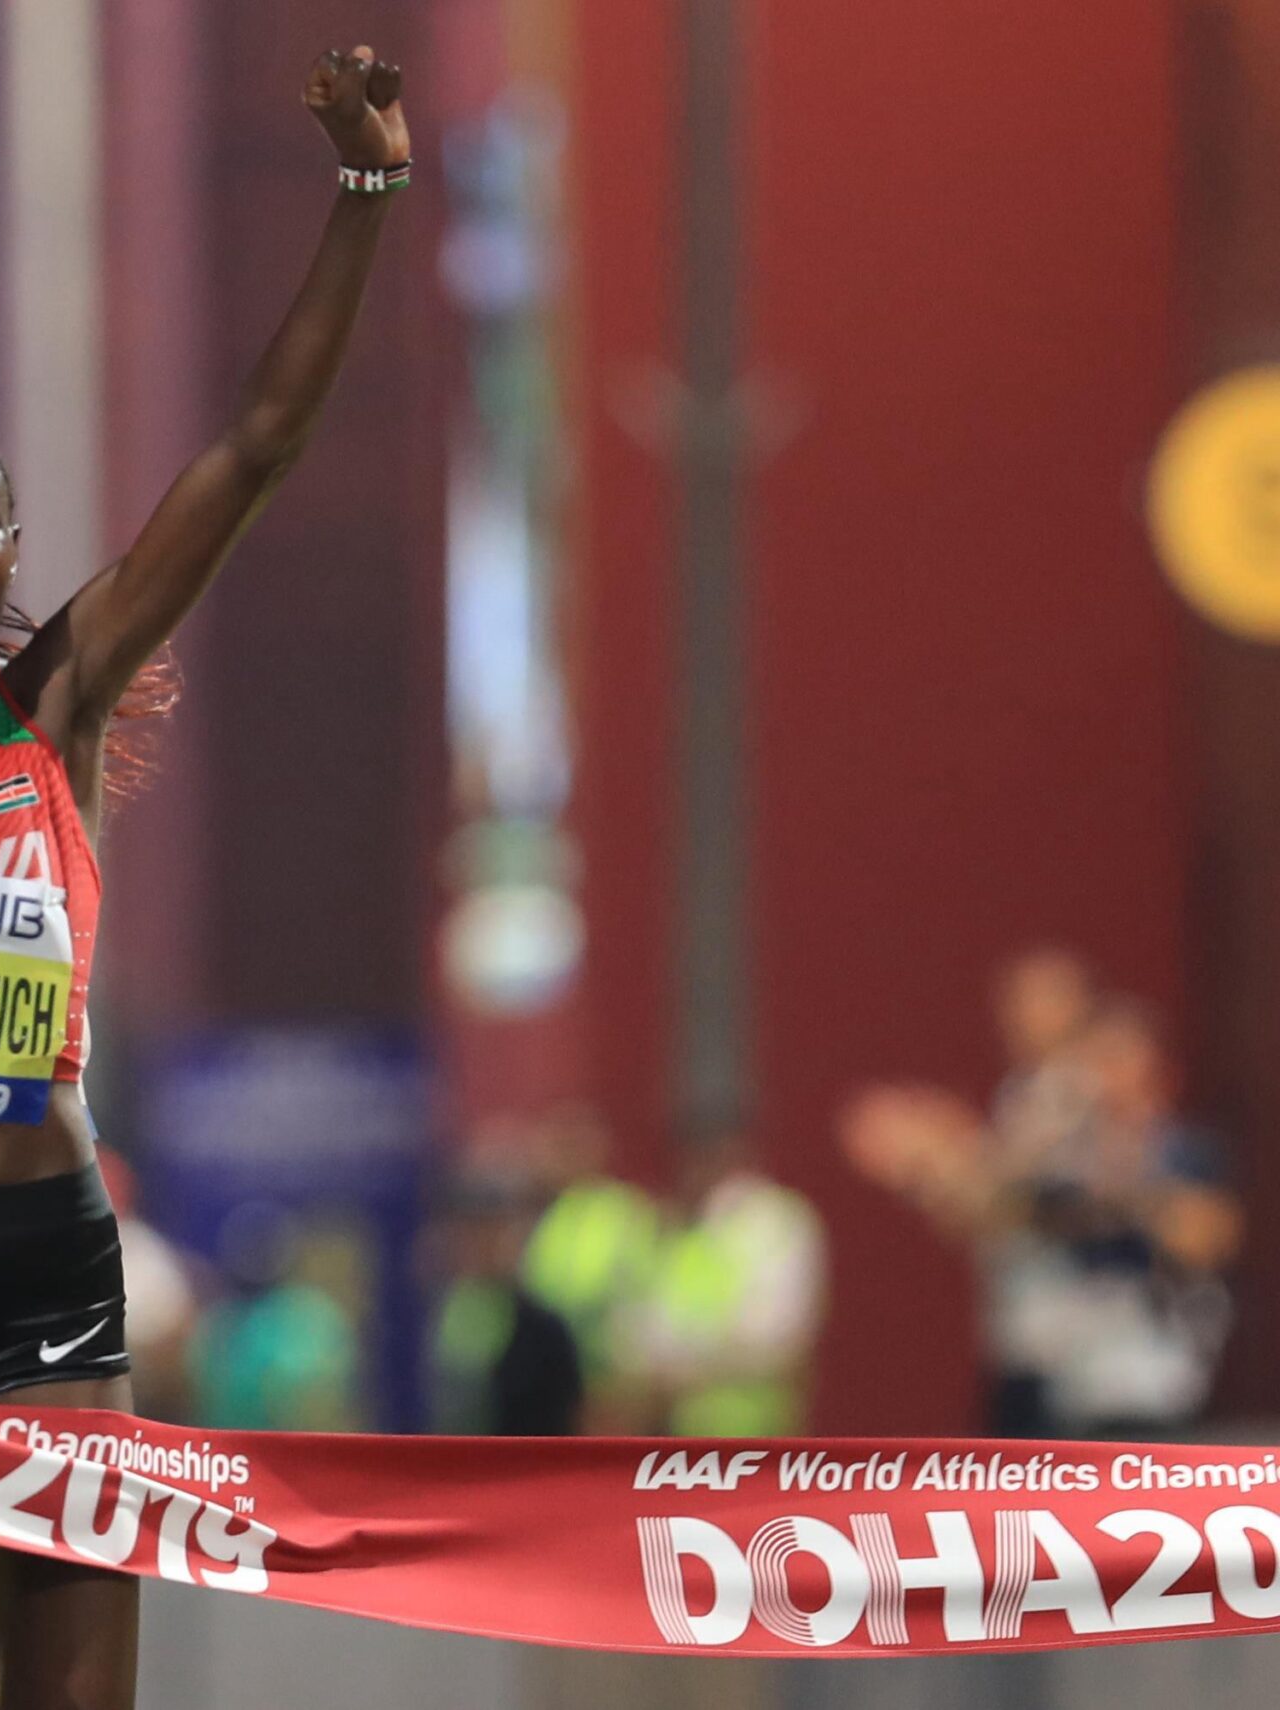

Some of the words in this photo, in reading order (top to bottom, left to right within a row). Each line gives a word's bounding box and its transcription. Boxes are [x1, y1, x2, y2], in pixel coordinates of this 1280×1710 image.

[632, 1451, 769, 1490] IAAF
[777, 1451, 904, 1492] World
[911, 1451, 1100, 1492] Athletics
[1110, 1453, 1280, 1494] Champi
